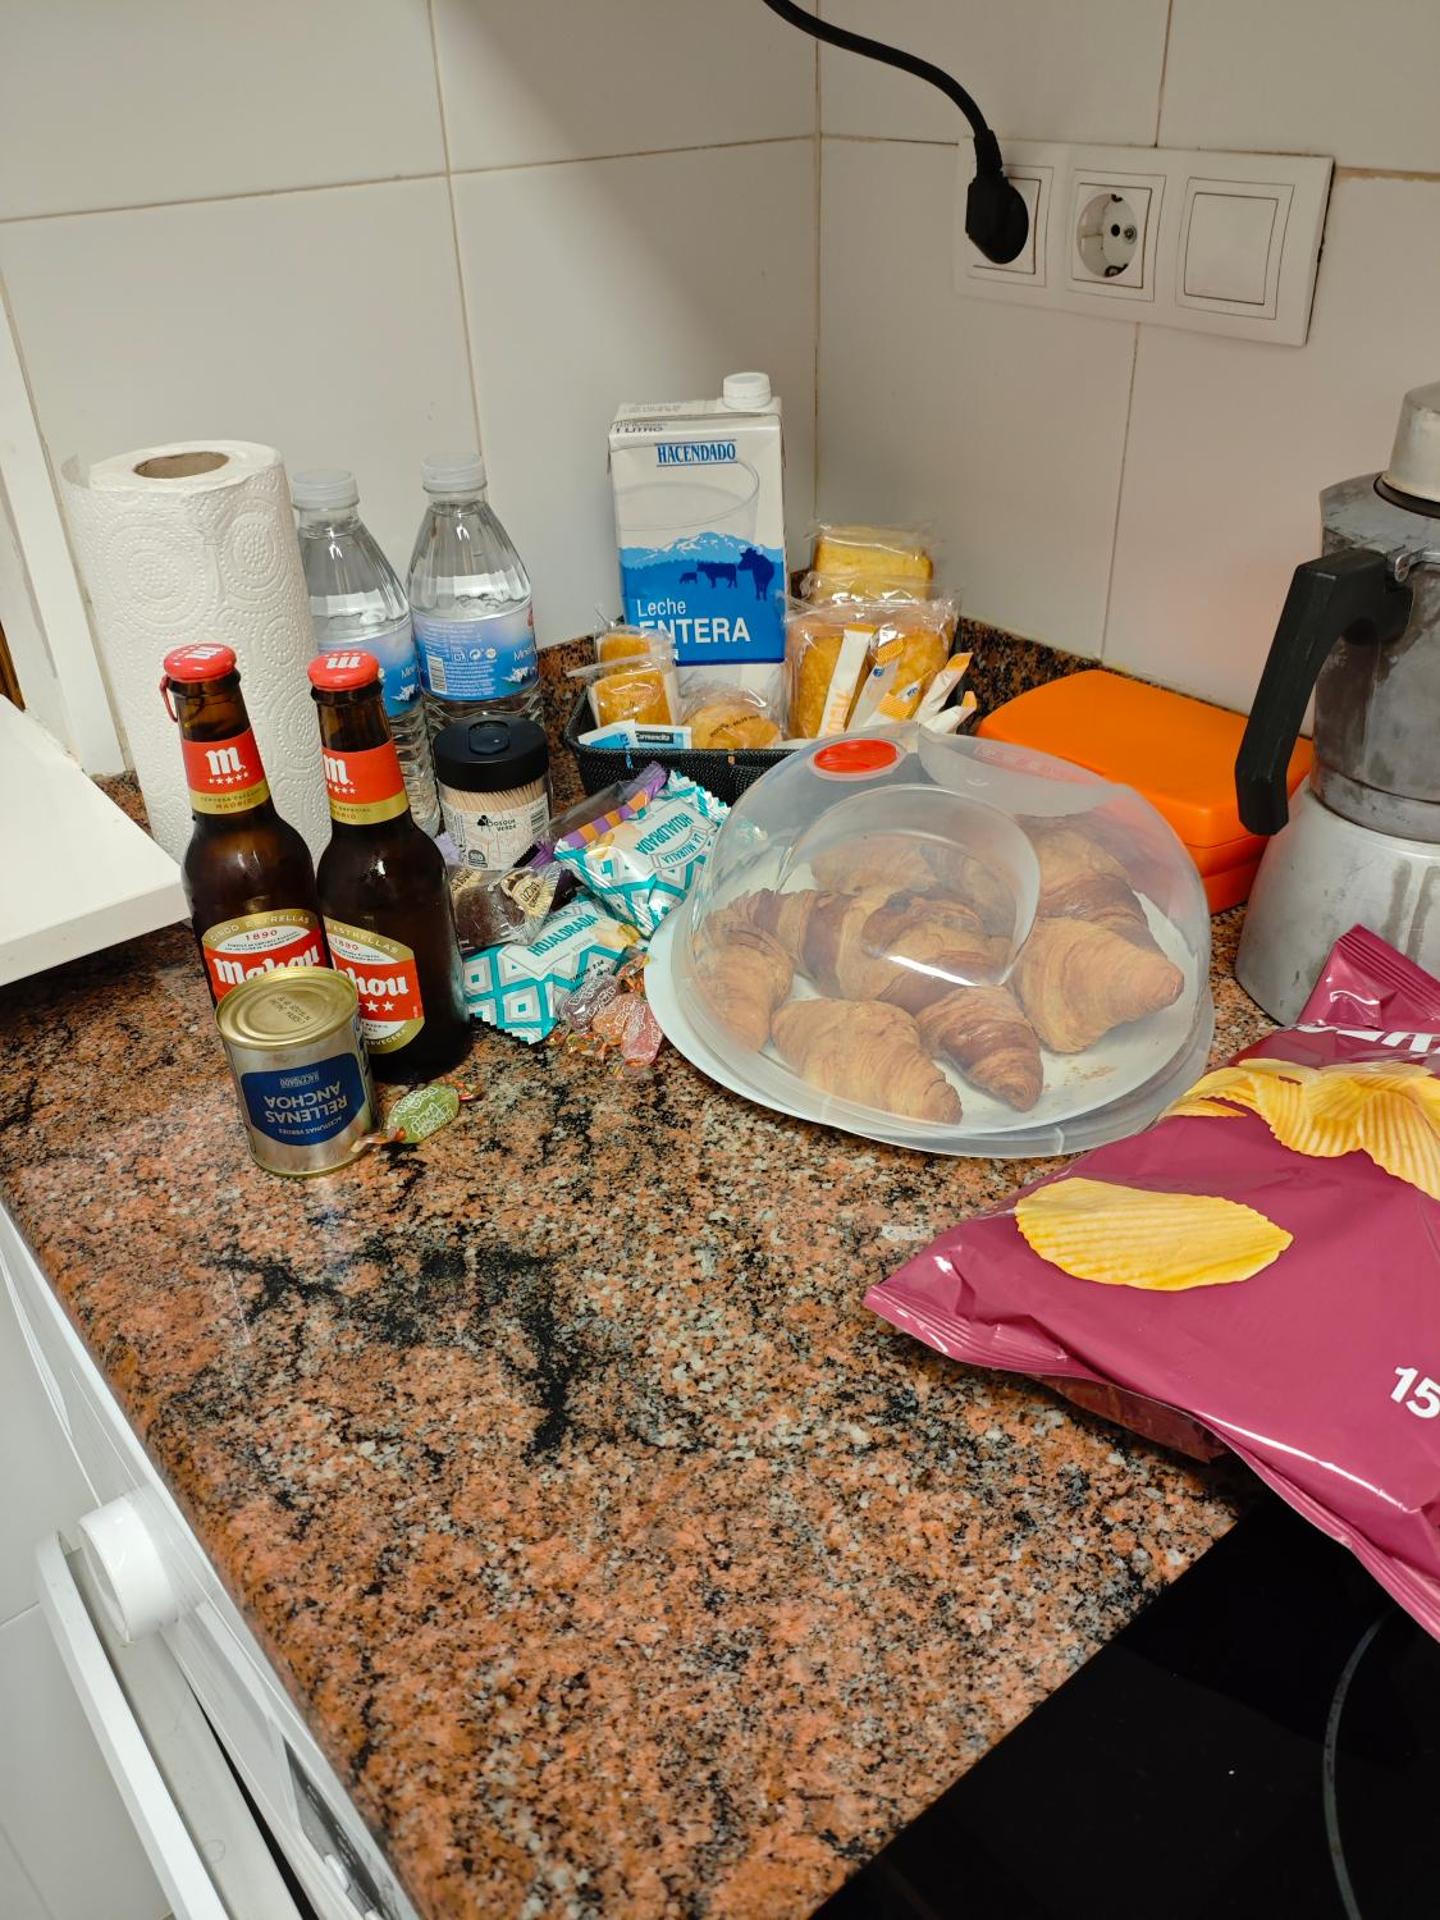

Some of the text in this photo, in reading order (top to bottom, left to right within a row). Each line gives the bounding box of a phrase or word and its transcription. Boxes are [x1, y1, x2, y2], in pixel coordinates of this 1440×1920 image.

[657, 443, 736, 463] HACENDADO
[637, 599, 686, 617] Leche
[635, 812, 694, 855] HOJALDRADA
[245, 929, 278, 941] 1890
[527, 913, 598, 956] HOJALDRADA
[263, 1080, 341, 1109] ANCHOA
[265, 1095, 348, 1123] RELLENAS
